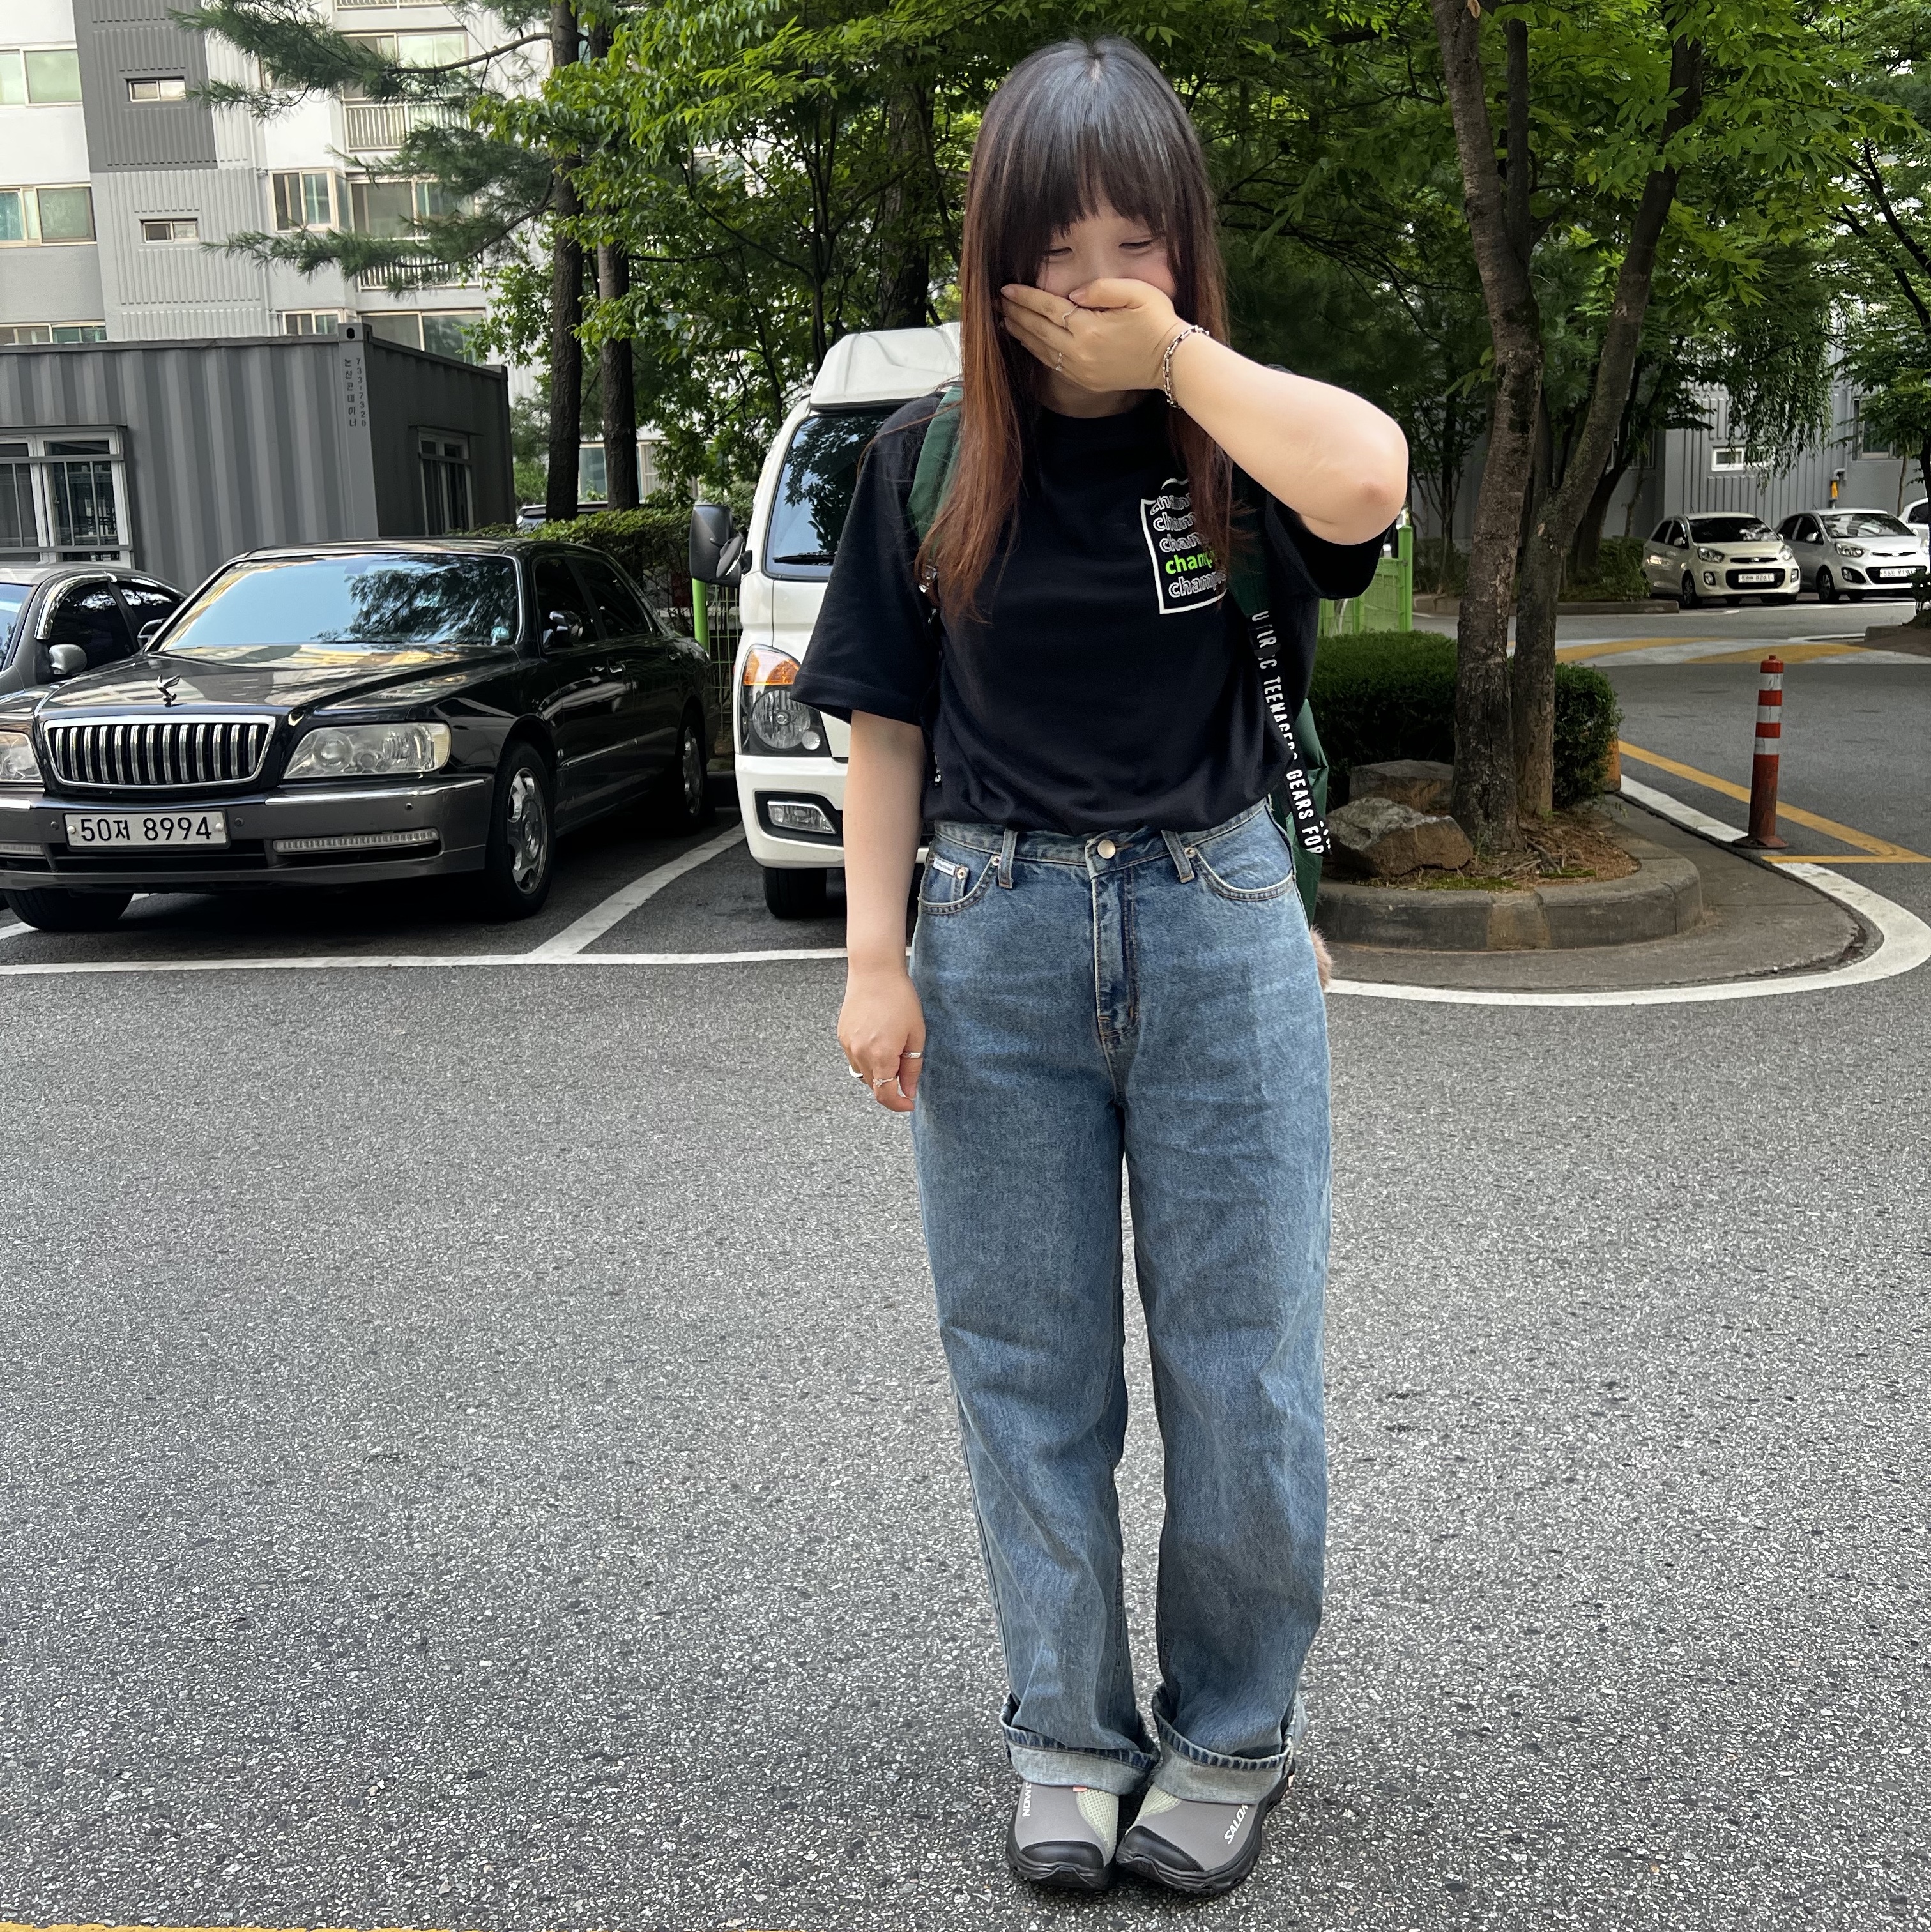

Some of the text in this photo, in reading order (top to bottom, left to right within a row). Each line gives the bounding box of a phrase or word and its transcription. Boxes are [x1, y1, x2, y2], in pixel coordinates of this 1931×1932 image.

[1263, 676, 1298, 760] TEENAGE
[1286, 769, 1314, 820] GEARS
[80, 816, 212, 842] 50저 8994
